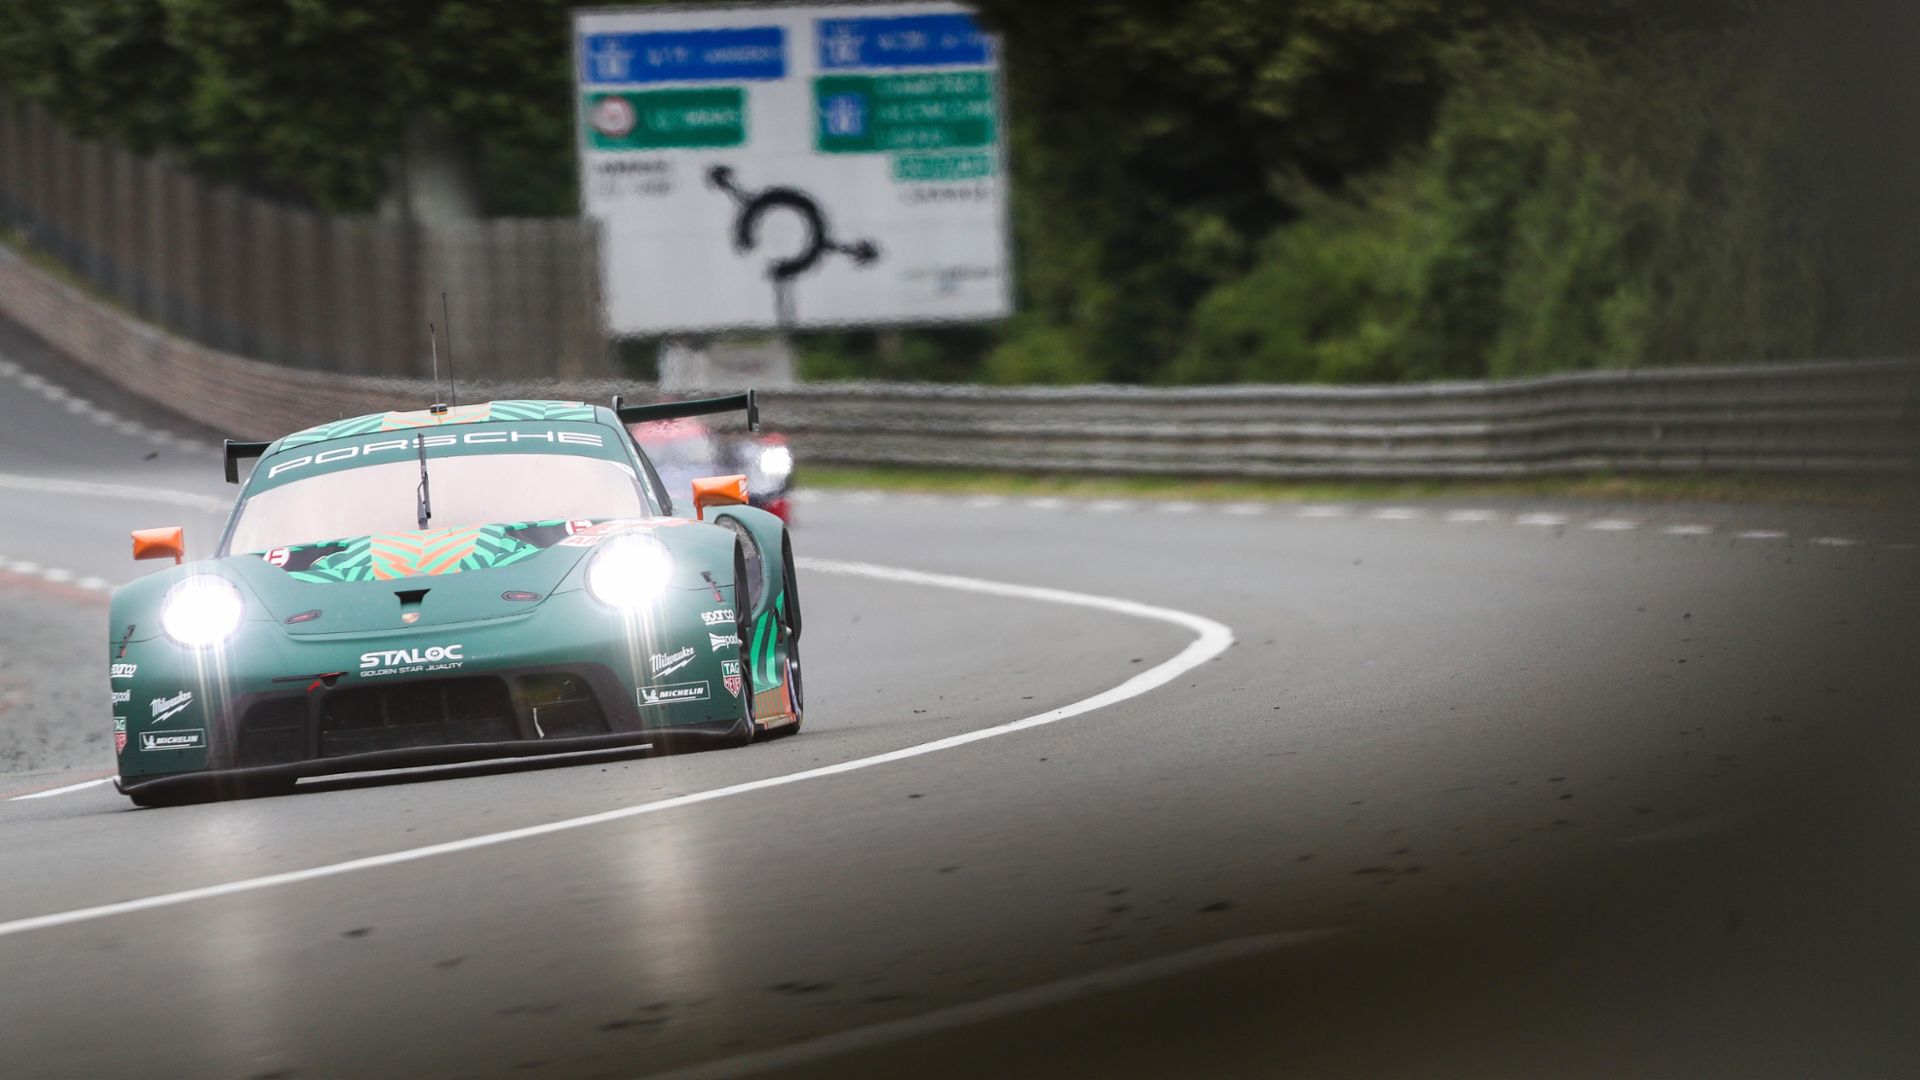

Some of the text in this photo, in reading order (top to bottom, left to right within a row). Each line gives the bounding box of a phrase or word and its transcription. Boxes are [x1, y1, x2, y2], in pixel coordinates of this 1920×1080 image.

[267, 430, 603, 479] PORSCHE
[701, 609, 734, 622] sparco
[359, 644, 464, 668] STALOC
[649, 646, 695, 673] Milwaukee
[360, 668, 397, 678] GOLDEN
[398, 665, 423, 674] STAR
[724, 662, 740, 675] TAG
[659, 687, 704, 698] MICHELIN
[156, 735, 199, 745] MICHELIN
